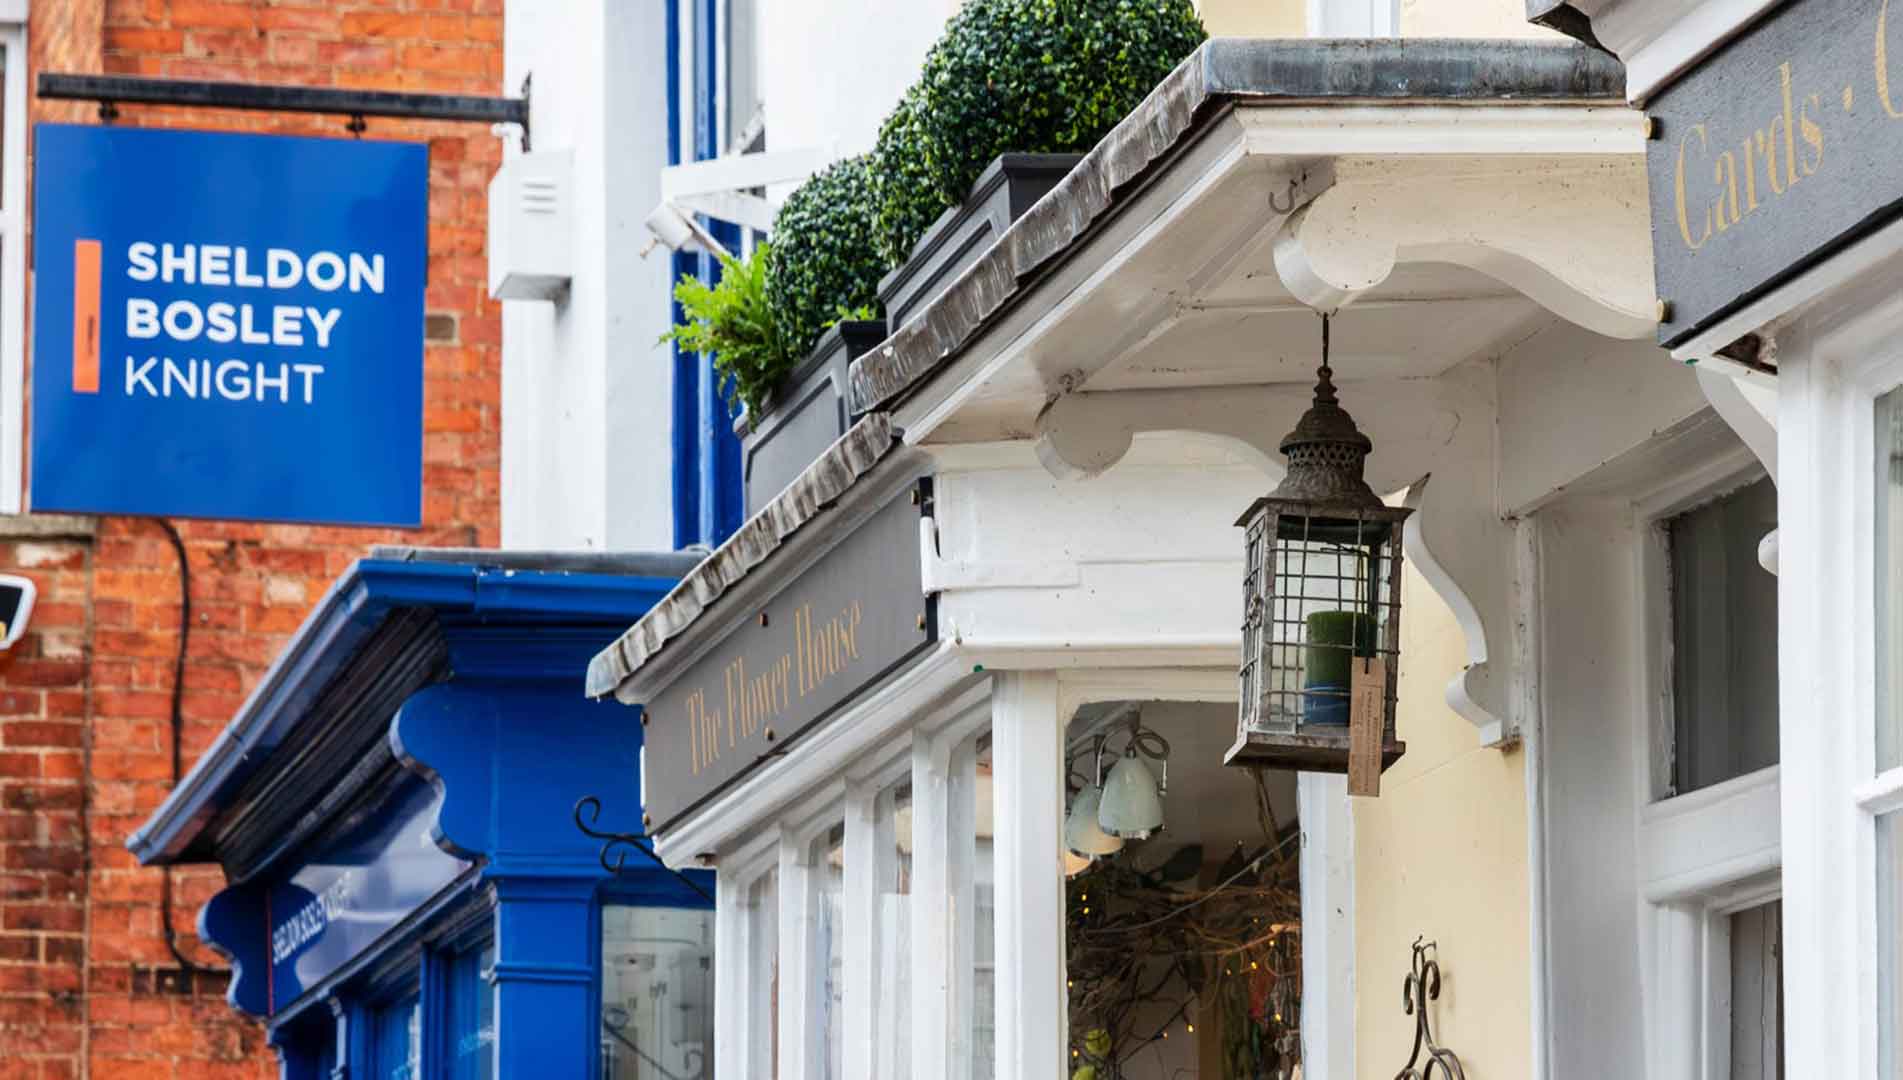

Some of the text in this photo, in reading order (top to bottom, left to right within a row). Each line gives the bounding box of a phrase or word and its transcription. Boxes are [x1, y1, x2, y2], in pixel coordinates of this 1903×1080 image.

[1676, 61, 1825, 250] Cards
[126, 241, 385, 293] SHELDON
[126, 298, 341, 348] BOSLEY
[124, 355, 325, 404] KNIGHT
[686, 599, 861, 776] The Flower House
